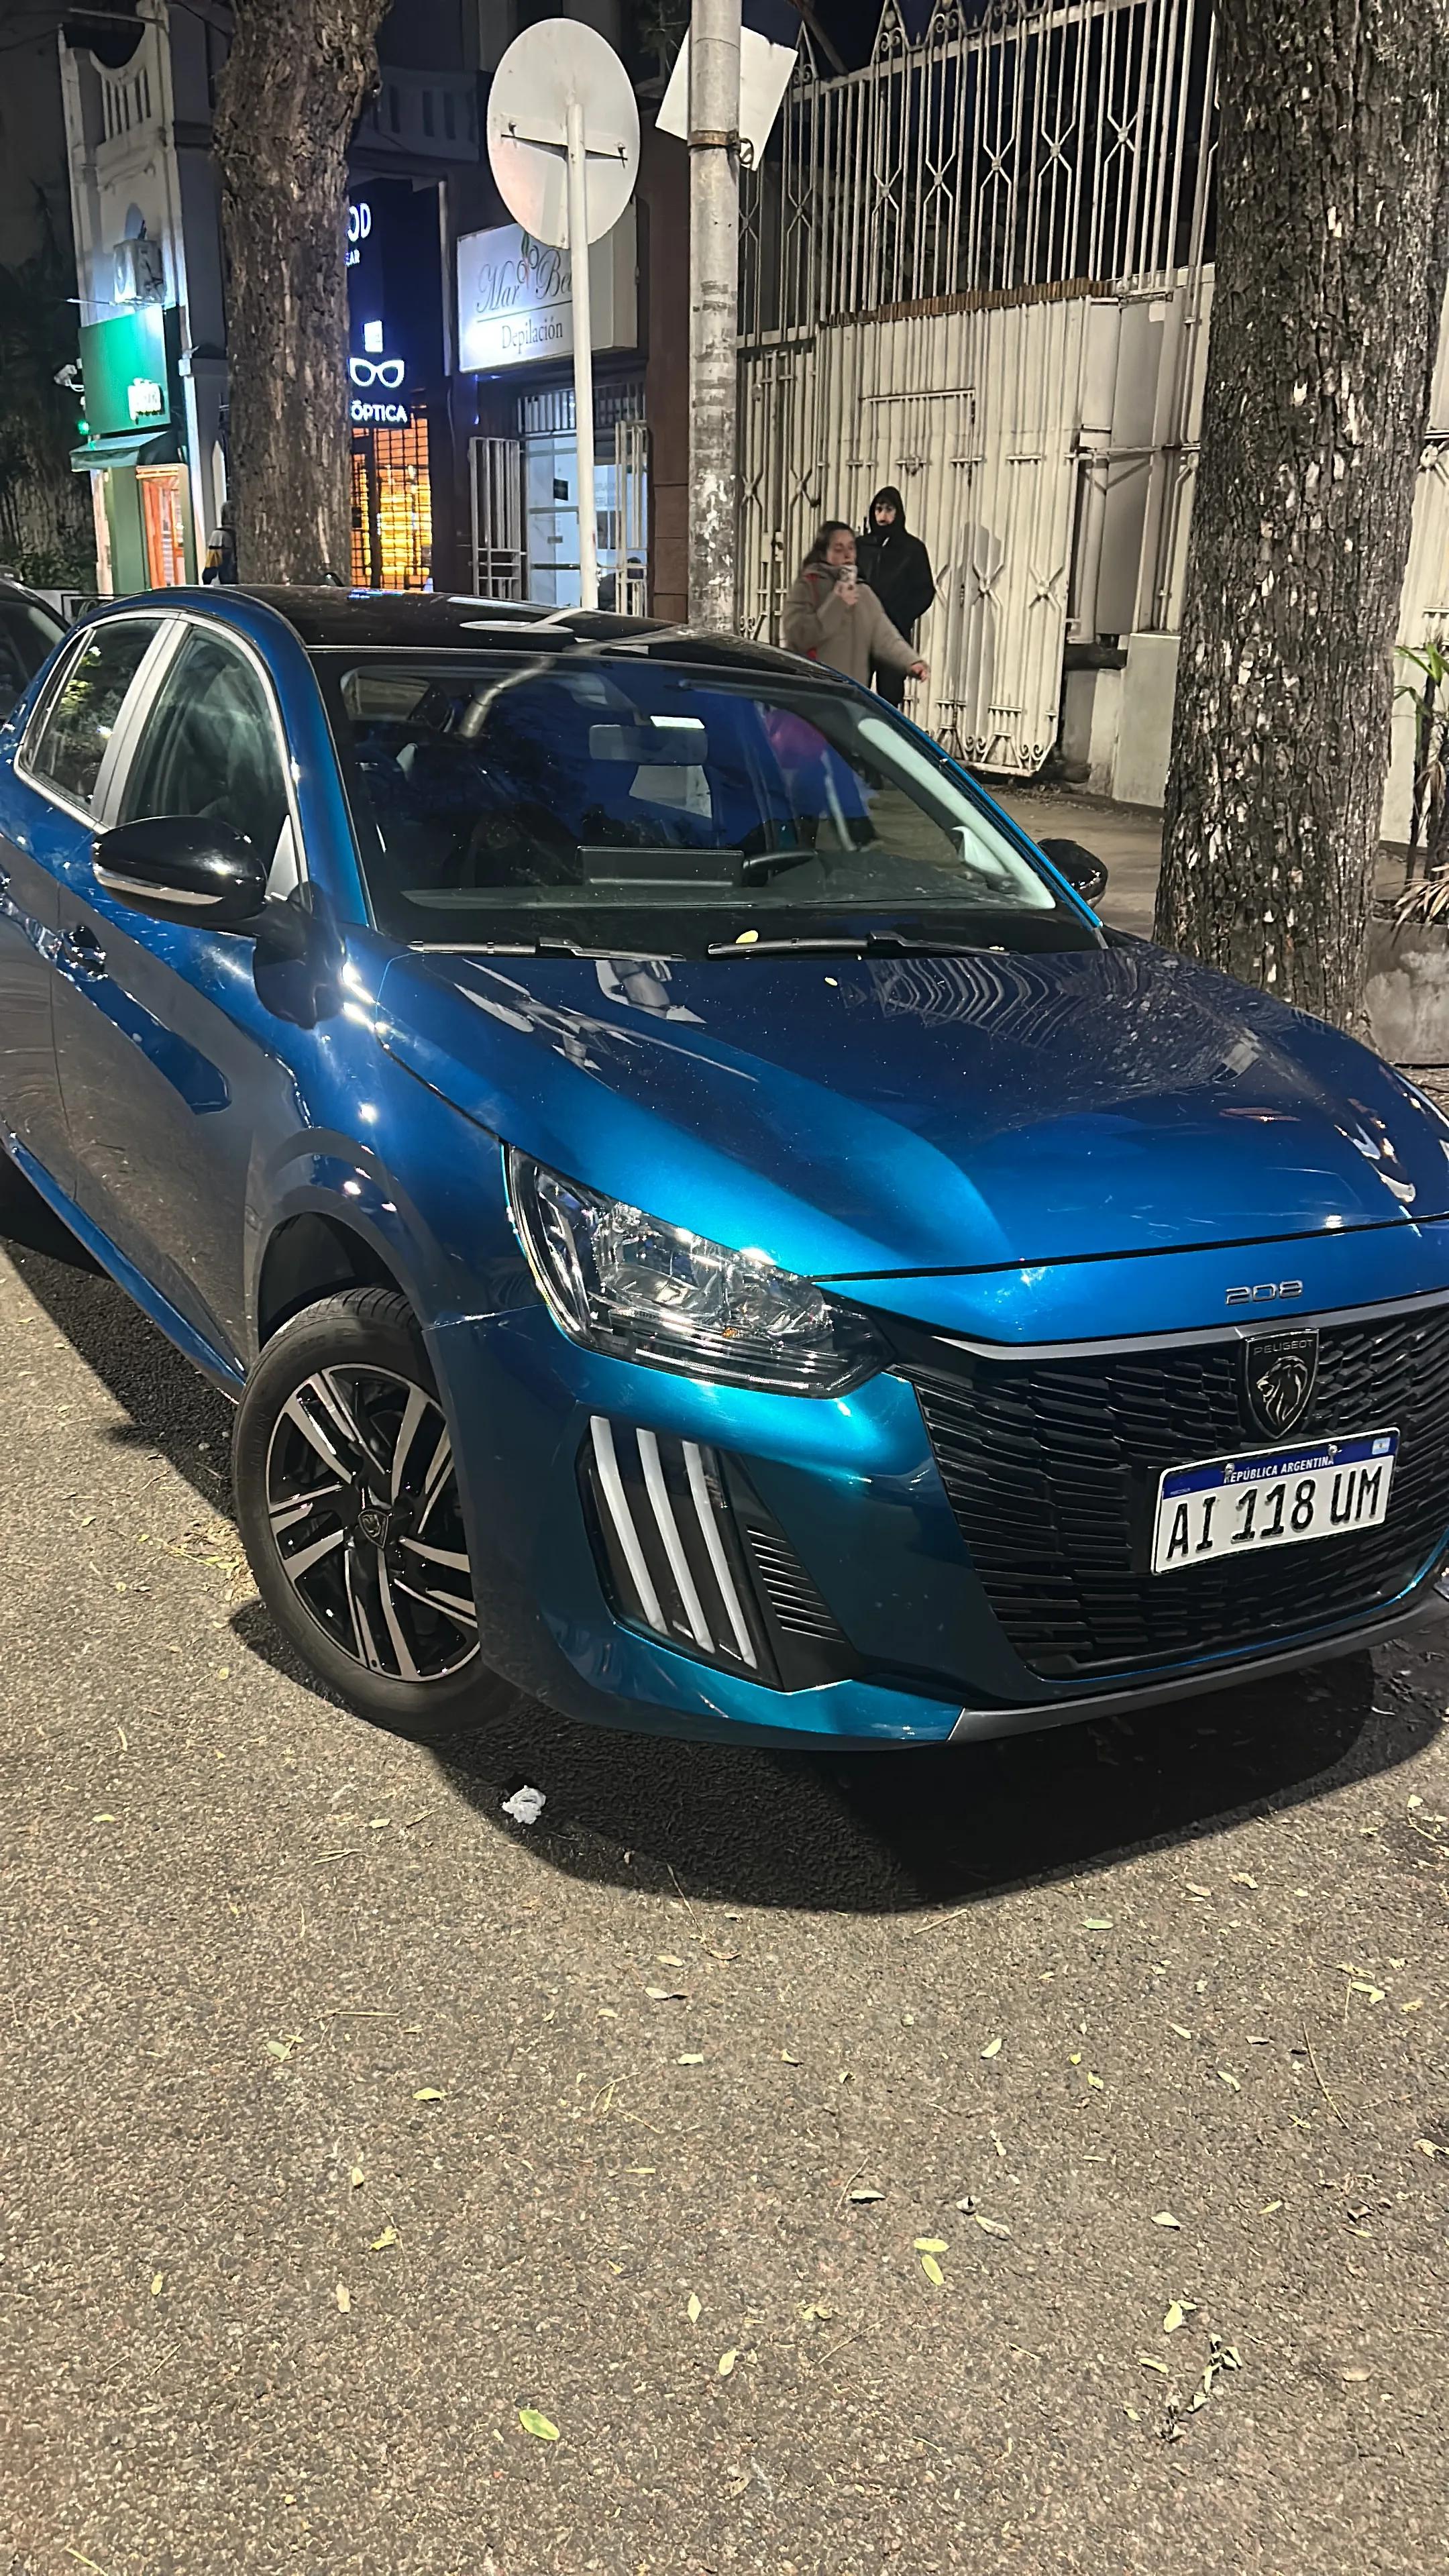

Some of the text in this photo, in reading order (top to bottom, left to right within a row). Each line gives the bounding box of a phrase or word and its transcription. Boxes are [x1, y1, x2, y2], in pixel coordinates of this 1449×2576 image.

[476, 260, 520, 313] Mar
[502, 317, 563, 354] Depilación
[1225, 1280, 1303, 1305] 208
[1253, 1339, 1313, 1356] PEUGEOT
[1165, 1465, 1383, 1562] AI 118 UM
